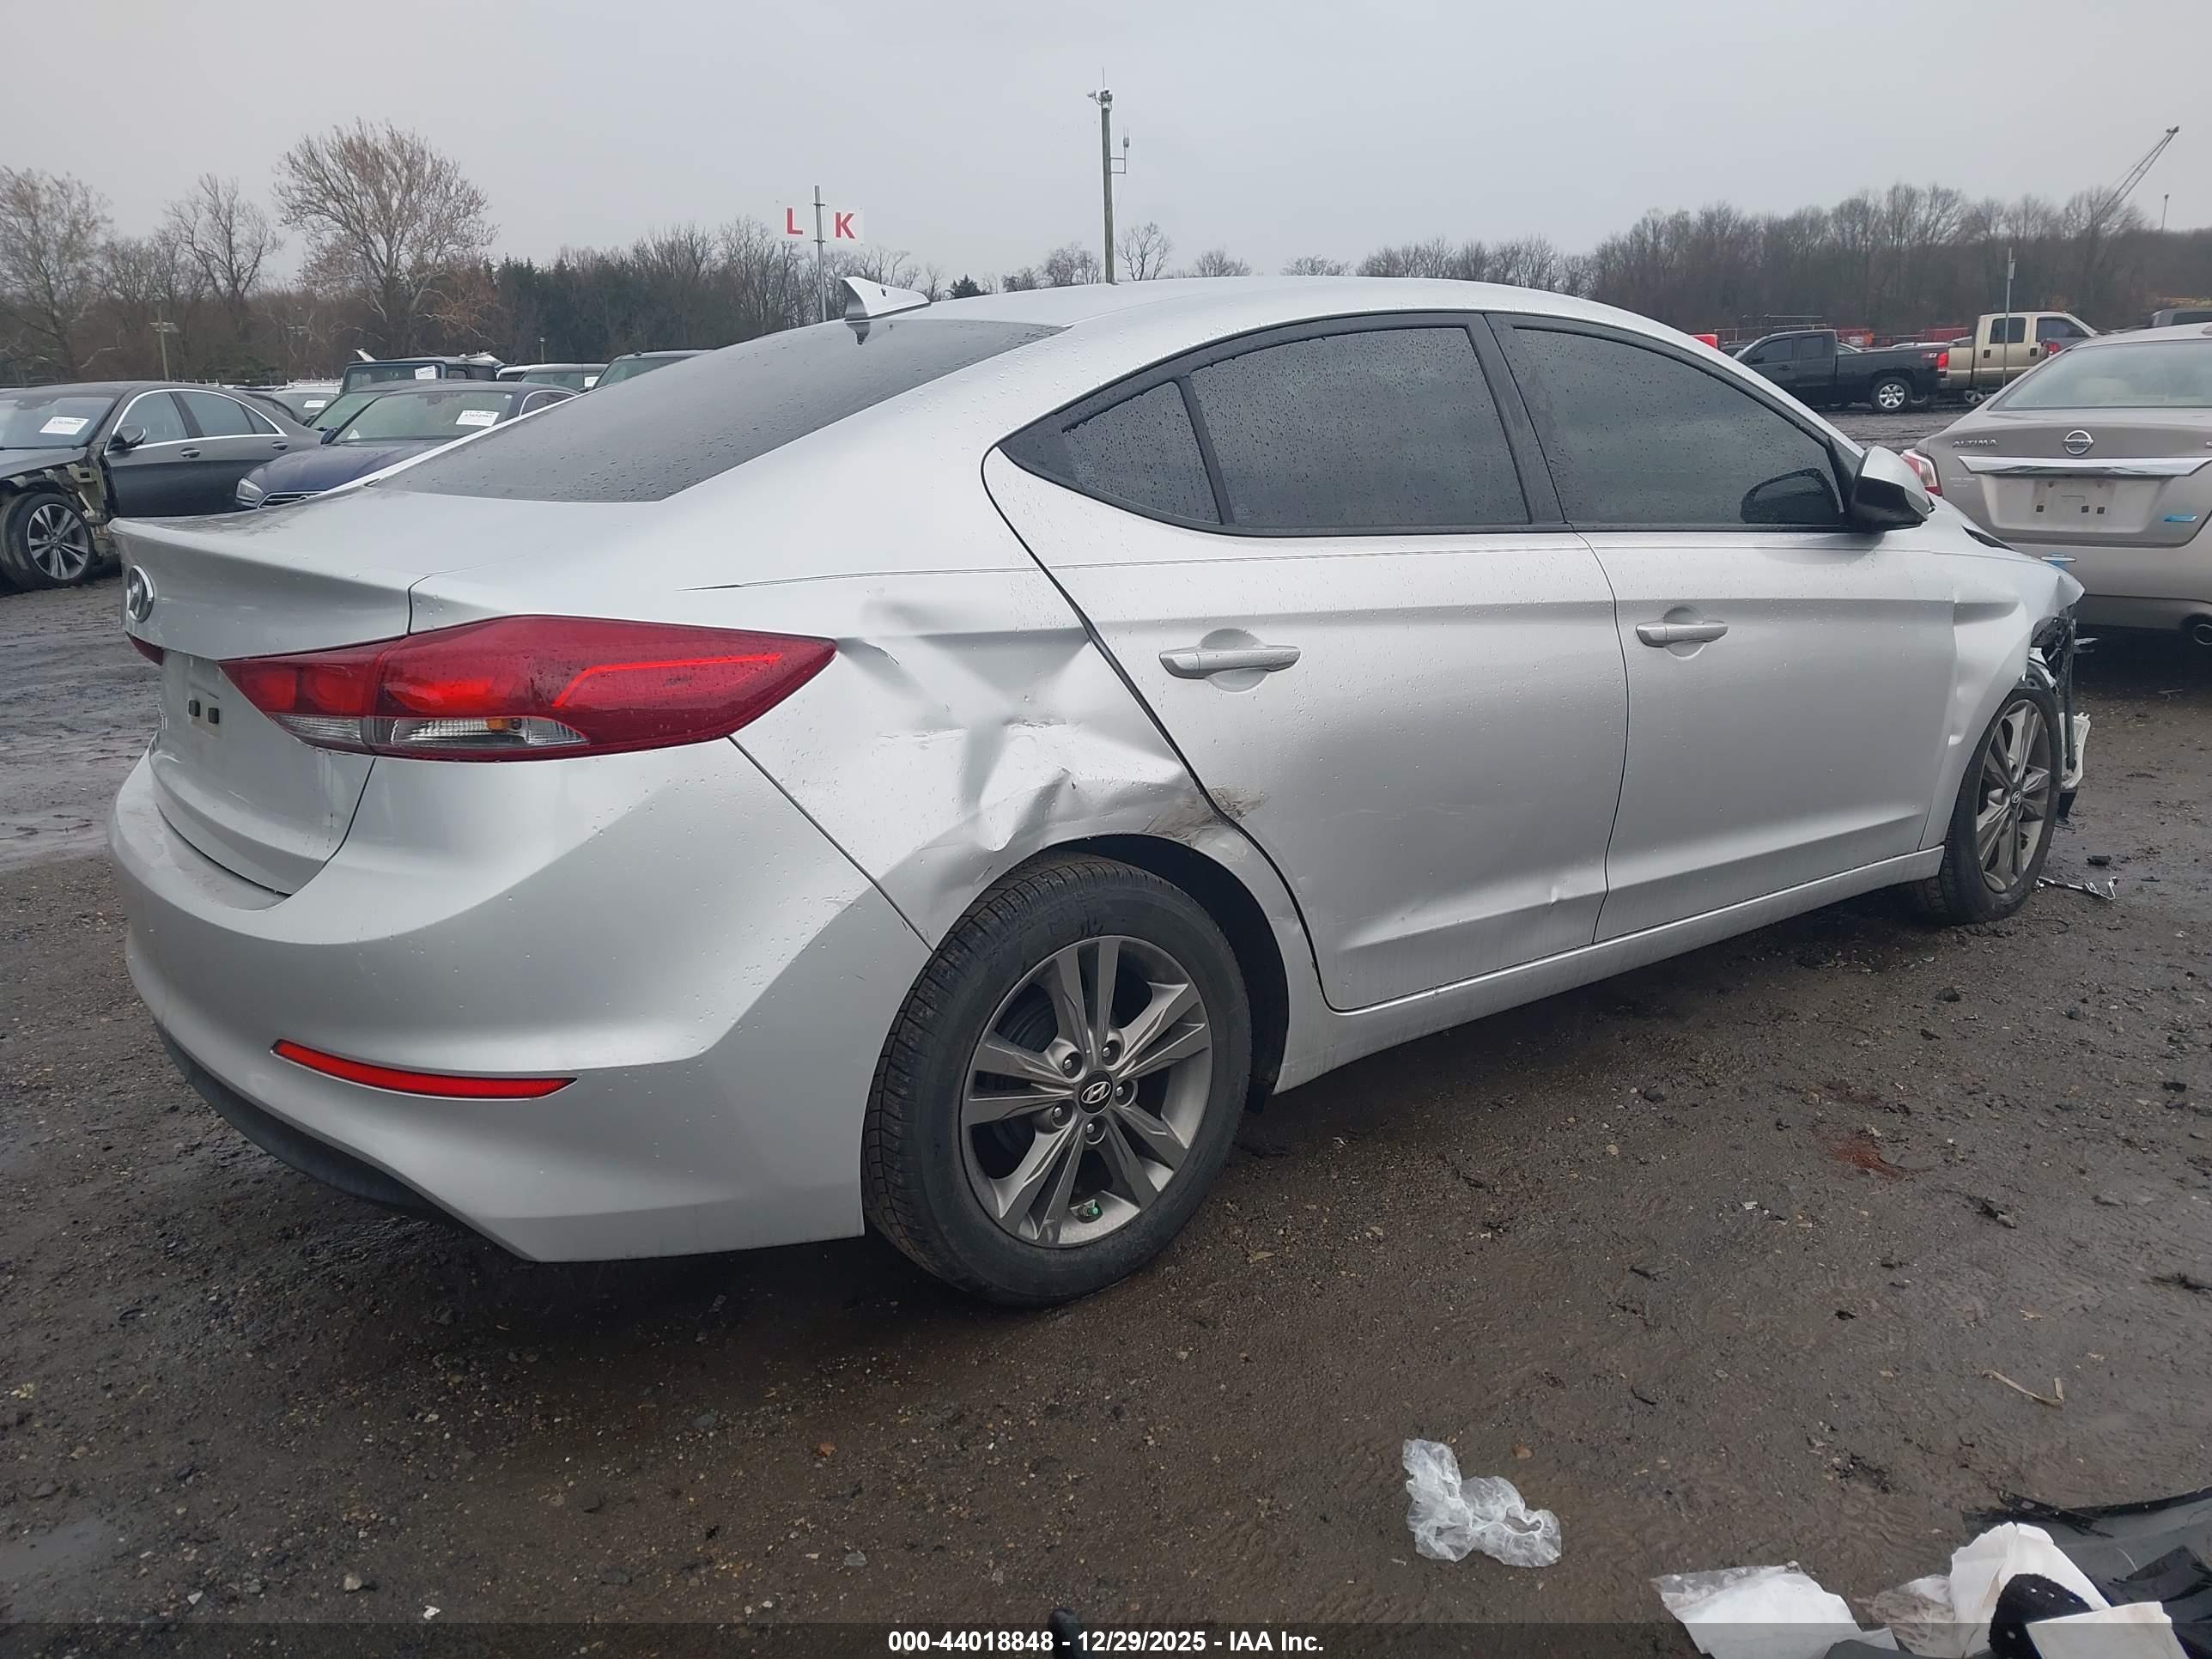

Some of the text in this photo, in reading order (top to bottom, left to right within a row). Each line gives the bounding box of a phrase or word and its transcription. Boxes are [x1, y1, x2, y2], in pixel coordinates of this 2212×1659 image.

[787, 208, 855, 239] L K
[1952, 439, 1999, 447] ALTIMA
